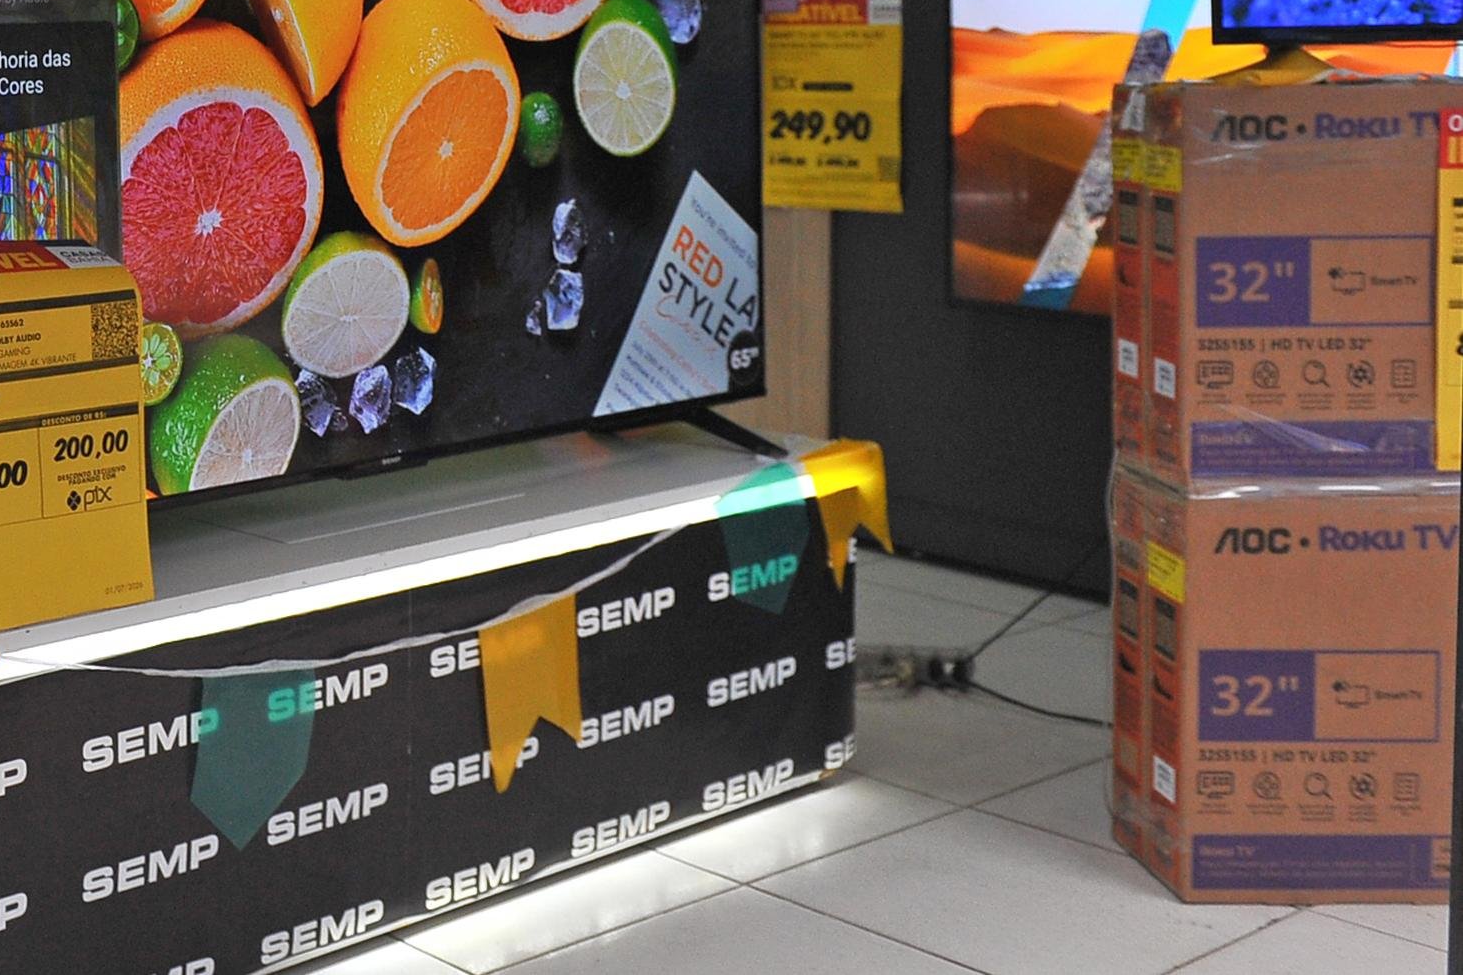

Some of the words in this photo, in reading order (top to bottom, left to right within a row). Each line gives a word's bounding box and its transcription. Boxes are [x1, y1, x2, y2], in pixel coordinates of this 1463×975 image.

[42, 49, 71, 68] das
[769, 109, 872, 144] 249,90
[1211, 113, 1289, 143] AOC
[671, 225, 724, 289] RED
[725, 277, 757, 326] LA
[1207, 261, 1295, 304] 32"
[1370, 275, 1403, 288] Smart
[1403, 275, 1419, 287] TV
[658, 261, 735, 349] STYLE
[16, 333, 41, 343] AUDIO
[42, 352, 77, 365] VIBRANTE
[1271, 339, 1292, 351] HD
[1297, 338, 1314, 350] TV
[1319, 338, 1345, 351] LED
[41, 414, 82, 426] DESCONTO
[83, 412, 94, 421] DE
[54, 429, 129, 462] 200,00
[57, 470, 91, 482] DESCONTO
[93, 464, 127, 476] EXCLUSIVO
[68, 474, 100, 485] PAGANDO
[102, 472, 116, 481] COM
[84, 486, 112, 512] pix
[1214, 527, 1292, 555] AOC
[1319, 525, 1406, 551] Roku
[1413, 525, 1458, 551] TV
[708, 554, 799, 602] SEMP
[577, 586, 676, 638] SEMP
[429, 639, 480, 678] SE
[267, 663, 390, 723] SEMP
[706, 656, 797, 708] SEMP
[1211, 675, 1300, 717] 32"
[82, 708, 219, 773] SEMP
[576, 694, 676, 748] SEMP
[1272, 750, 1295, 763] HD
[1299, 750, 1317, 762] TV
[1321, 750, 1348, 763] LED
[702, 758, 795, 812] SEMP
[267, 782, 390, 847] SEMP
[571, 801, 671, 858] SEMP
[82, 834, 219, 903] SEMP
[425, 848, 536, 911] SEMP
[260, 899, 385, 966] SEMP
